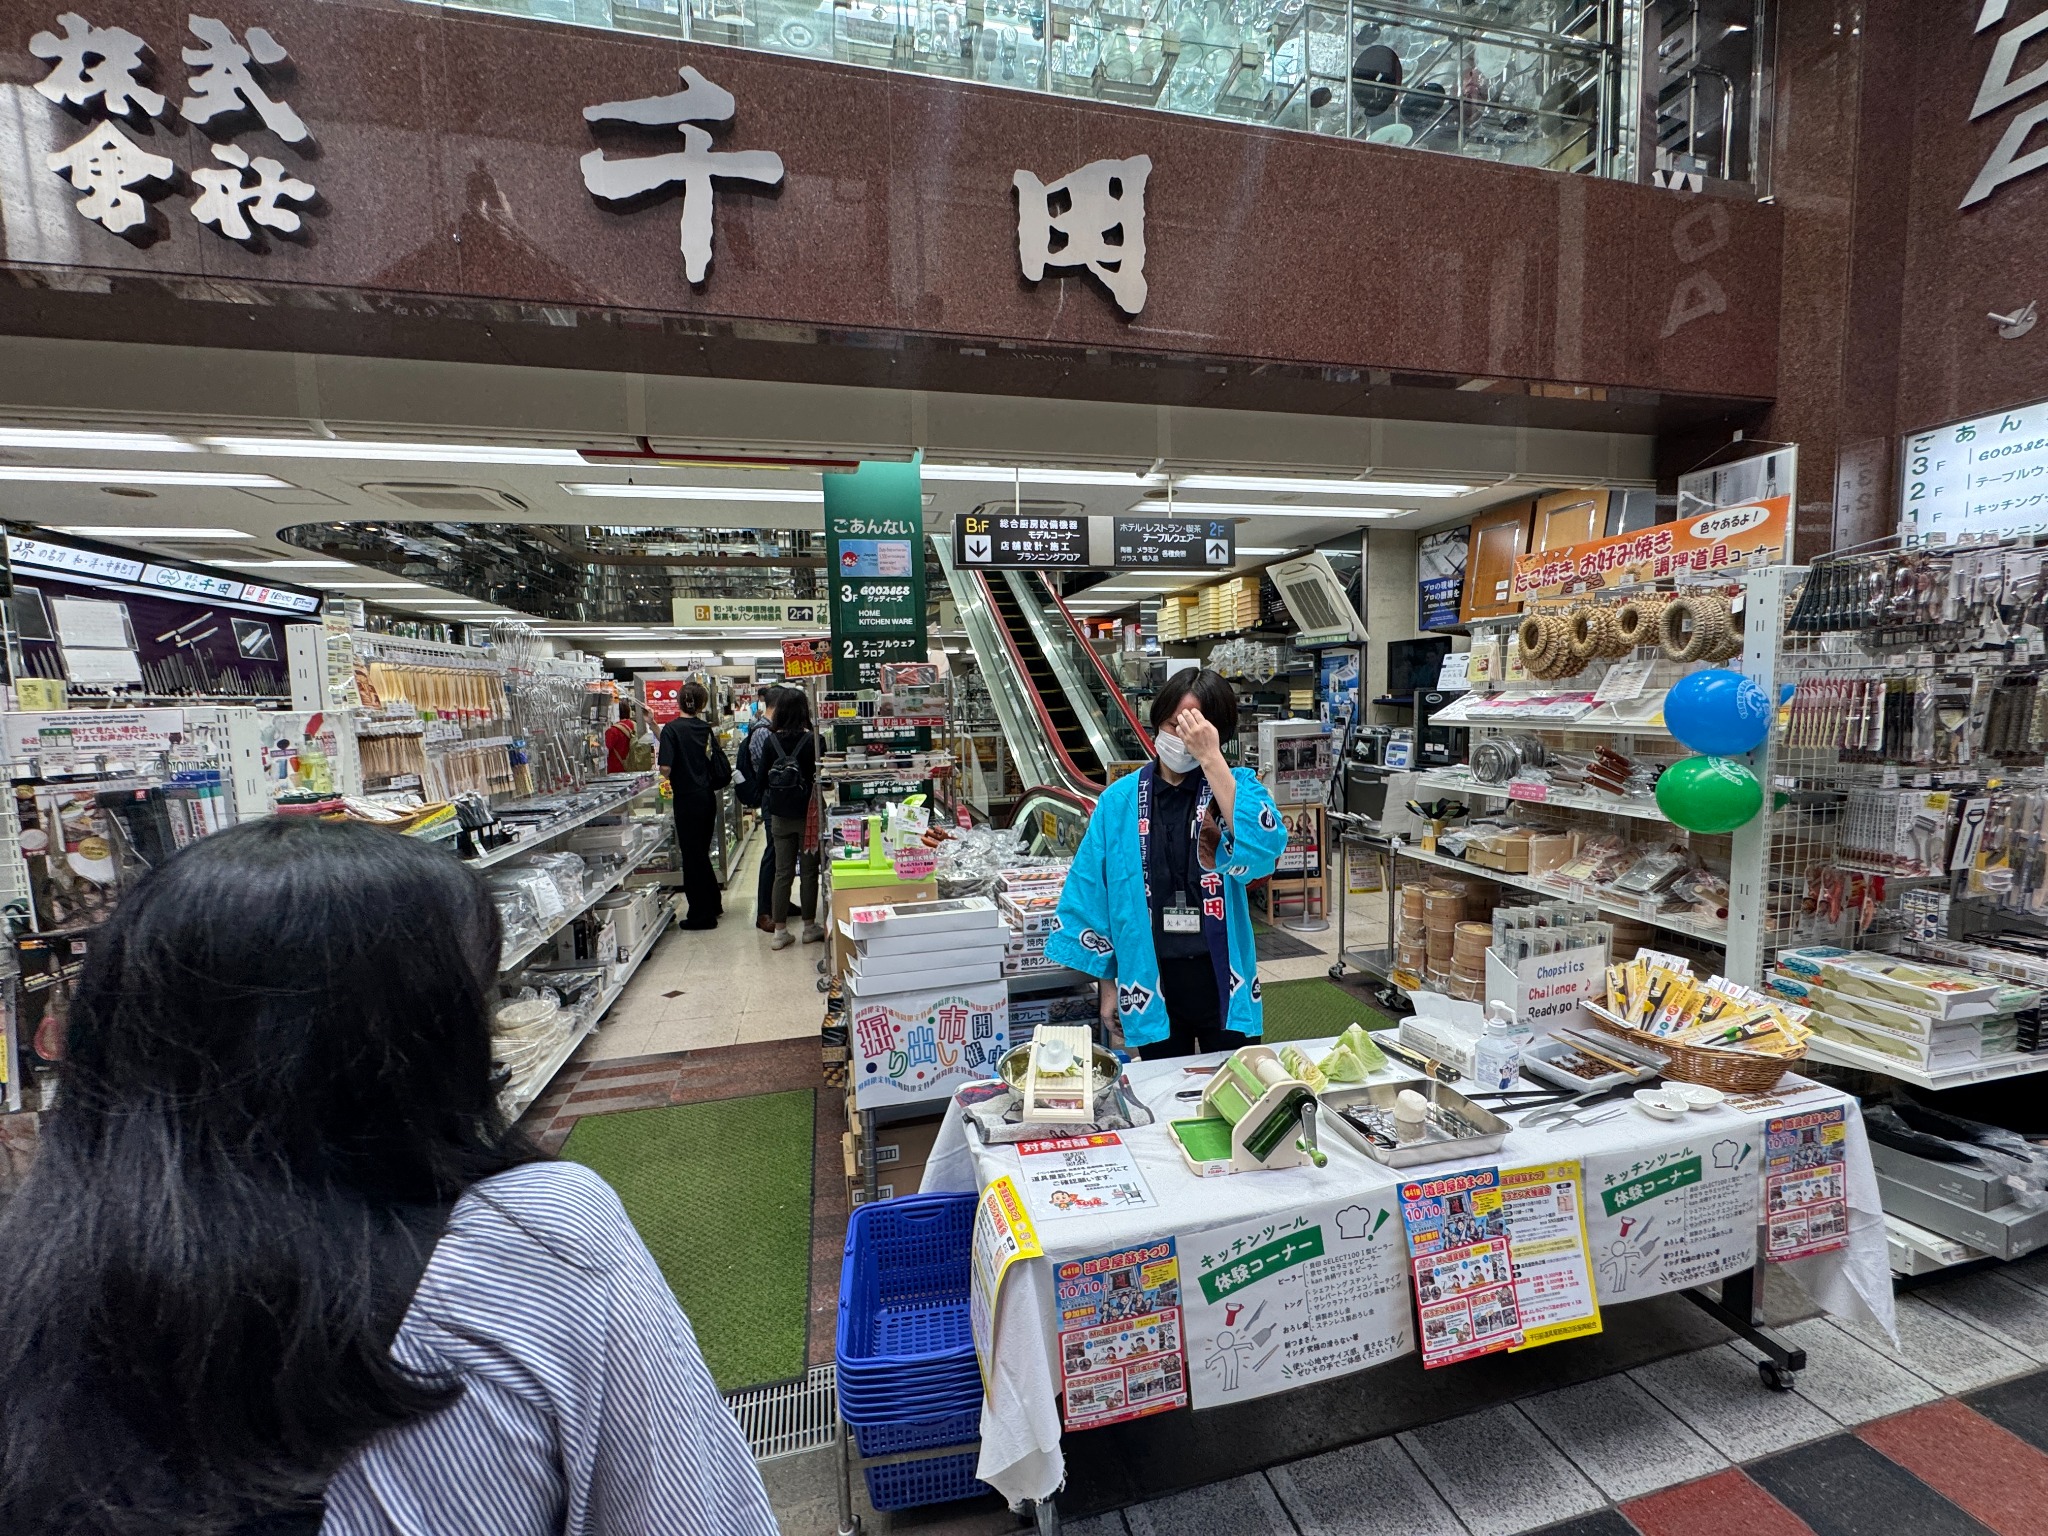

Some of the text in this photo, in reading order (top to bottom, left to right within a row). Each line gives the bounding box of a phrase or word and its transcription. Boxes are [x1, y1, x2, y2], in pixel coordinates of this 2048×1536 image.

[29, 13, 306, 142] 株式
[580, 66, 1152, 314] 千田
[1976, 465, 2048, 488] テーブルウ
[1973, 493, 2048, 514] キッチング
[833, 518, 915, 535] ごあんない
[966, 518, 989, 533] B1F
[999, 518, 1078, 530] 総合厨房設備機器
[1119, 523, 1202, 534] ホテル・レストラン・喫茶
[1209, 522, 1225, 537] 2F
[1028, 530, 1080, 540] モデルコーナー
[1142, 533, 1202, 543] テーブルウェアー
[1000, 541, 1070, 552] 店舗設計・施工
[1017, 552, 1081, 562] プランニングフロア
[1515, 531, 1672, 593] たこ焼き お好み焼き
[1653, 545, 1728, 578] 調理道具
[841, 585, 858, 602] 3F
[696, 607, 710, 619] B1
[789, 607, 802, 619] 2F
[858, 609, 881, 617] HOME
[858, 617, 914, 626] KITCHEN WARE
[843, 639, 915, 659] 2F テーブルウェア
[862, 649, 885, 658] フロア
[1537, 961, 1585, 979] Chopstics
[1528, 983, 1577, 1000] Challenge
[1022, 1138, 1090, 1152] 対象店舗
[1031, 1165, 1129, 1183] 道具屋筋ホームページにて
[1604, 1146, 1693, 1186] キッチンツール
[1424, 1172, 1493, 1198] 道具屋筋まつり
[1614, 1169, 1695, 1207] 体験コーナー
[1406, 1207, 1440, 1222] 10/10
[1200, 1216, 1309, 1268] キッチンツール
[1083, 1243, 1170, 1276] 道具屋筋まつり
[1214, 1240, 1313, 1293] 体験コーナー
[1323, 1252, 1360, 1267] SELECT100
[1330, 1255, 1382, 1271] セラミックピーラー
[1278, 1274, 1304, 1285] ピーラー
[1313, 1273, 1379, 1295] シェフトング ステンレス
[1356, 1273, 1401, 1292] エコノミータイプ
[1059, 1281, 1101, 1298] 10/10
[1284, 1299, 1303, 1310] トング
[1314, 1298, 1349, 1311] サンクラフト
[1317, 1308, 1375, 1329] ステンレス製おろし金
[1283, 1321, 1309, 1334] おろし金
[1307, 1333, 1359, 1353] 究極の滑らない箸
[1364, 1336, 1397, 1352] 重さなどを
